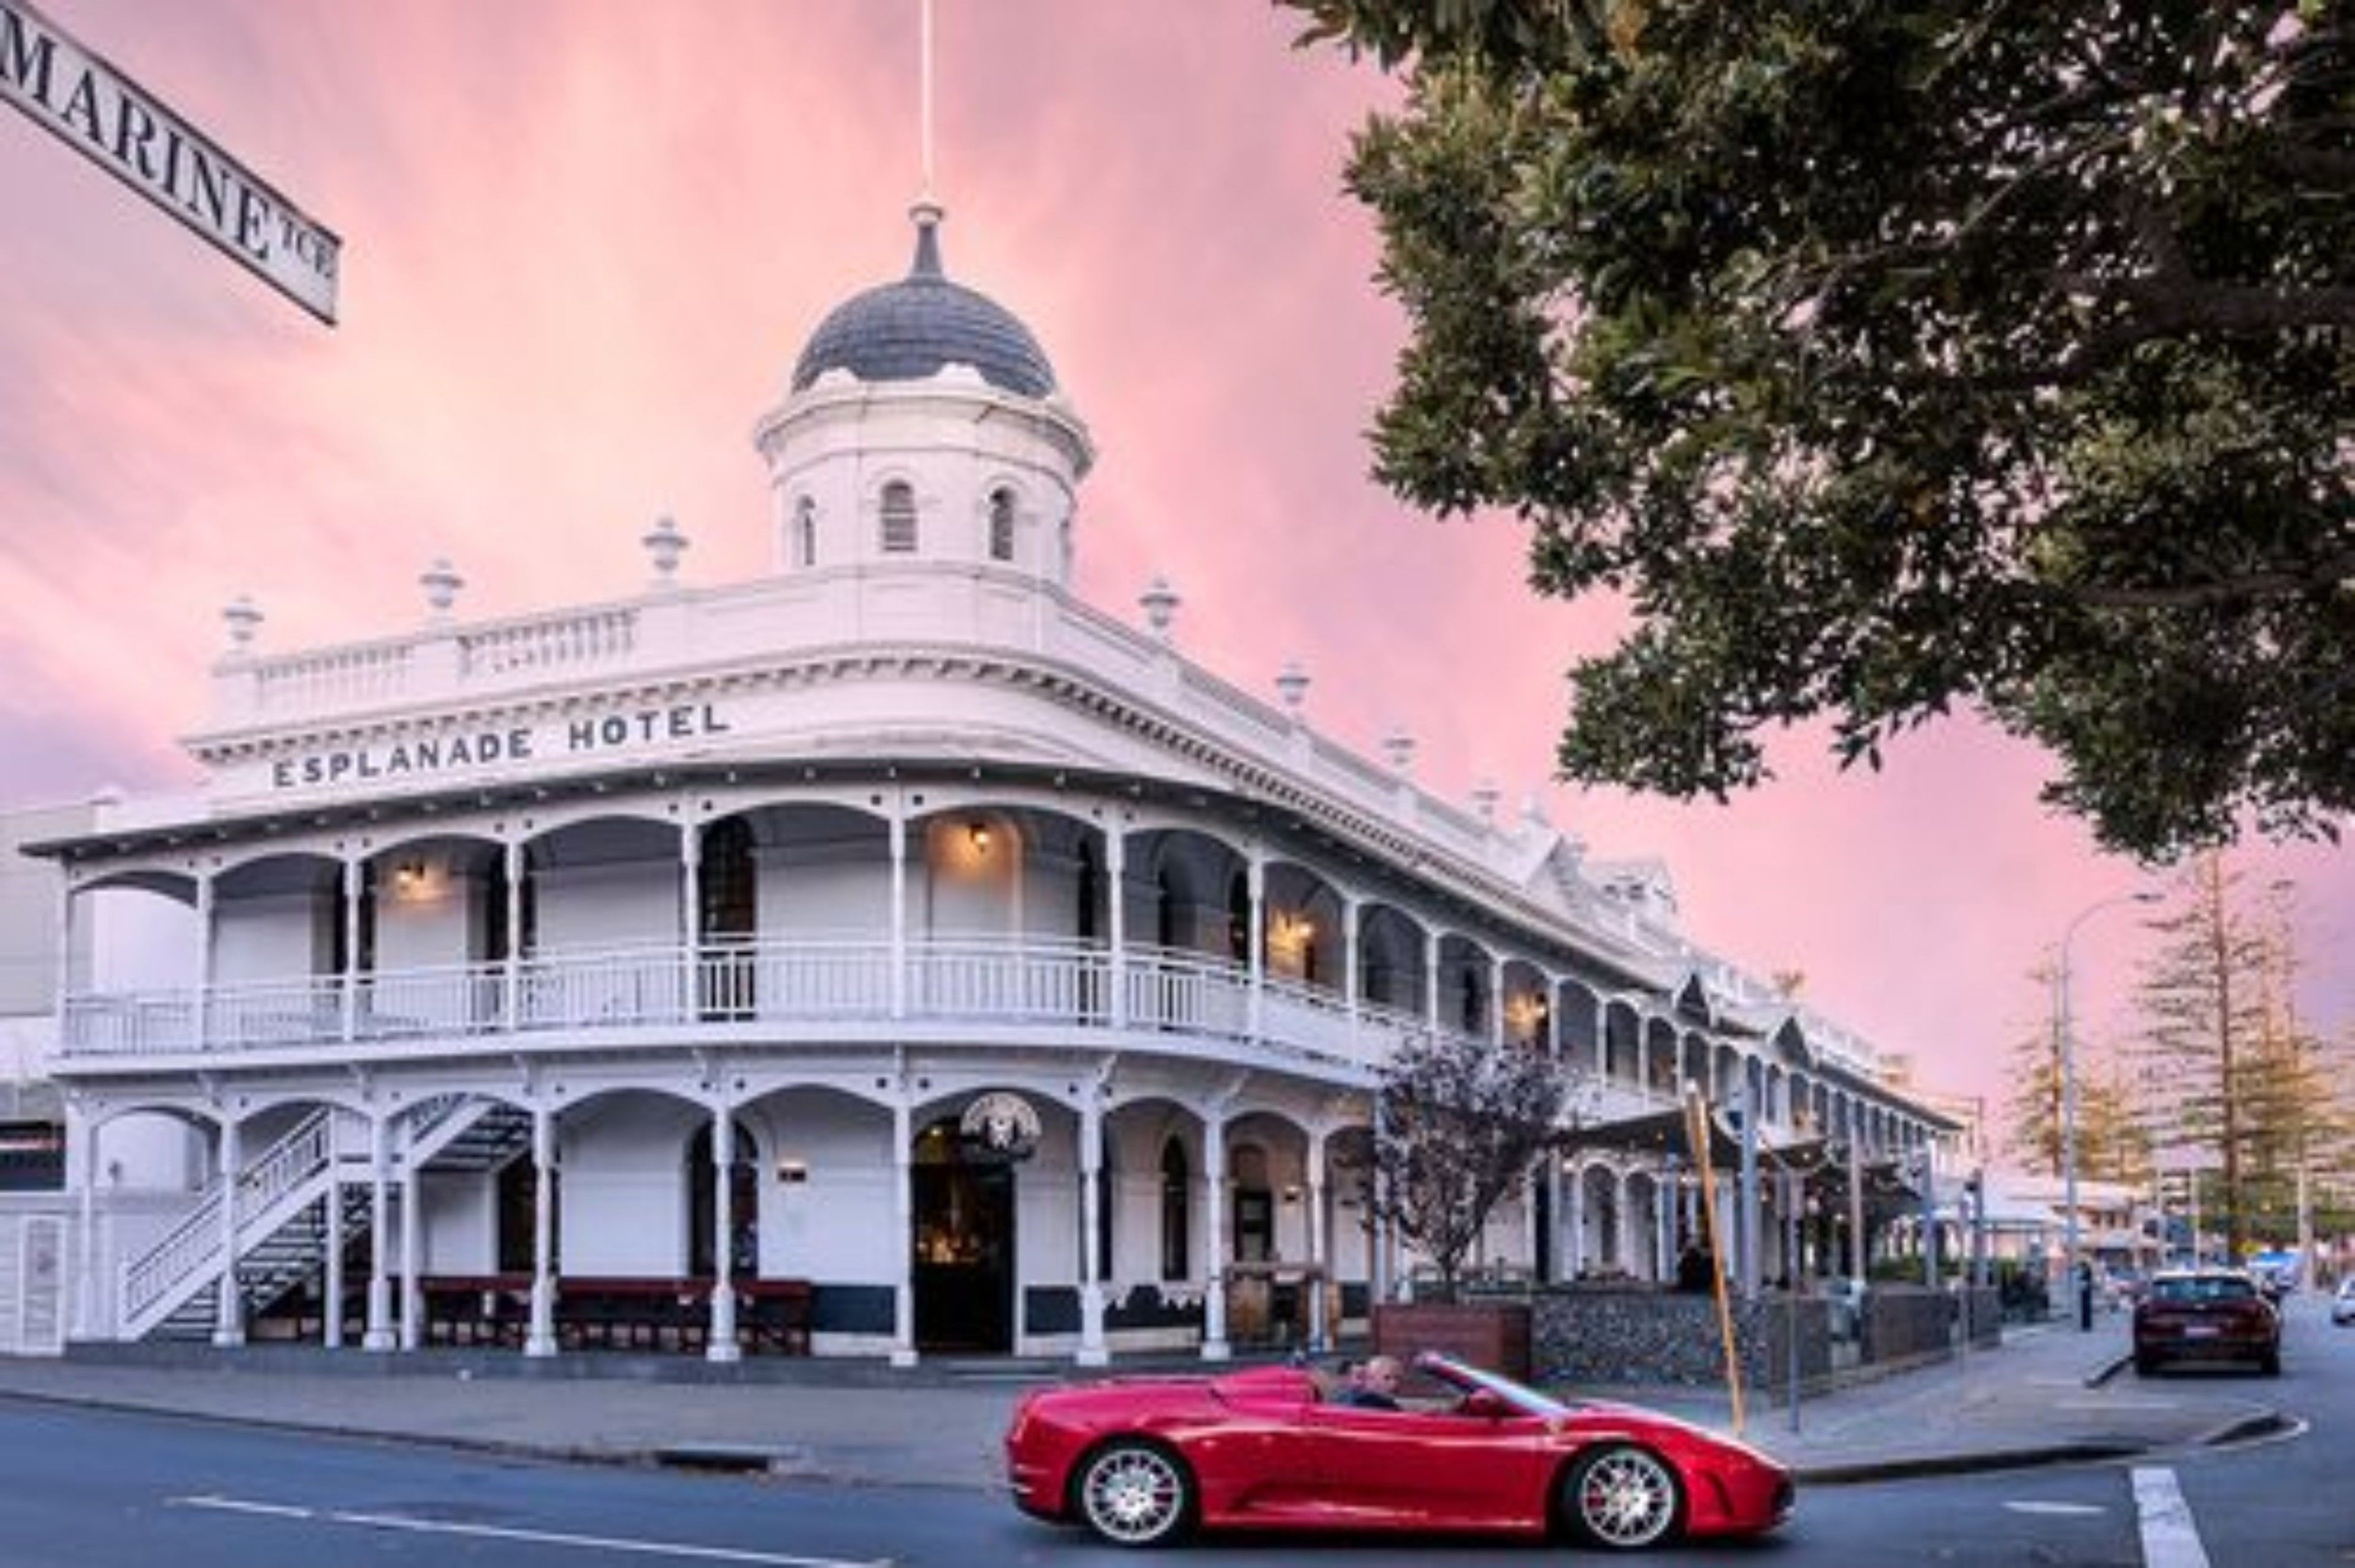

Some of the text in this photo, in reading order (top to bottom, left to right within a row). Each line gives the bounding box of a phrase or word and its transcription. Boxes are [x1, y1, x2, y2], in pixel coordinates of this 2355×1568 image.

[0, 8, 333, 278] MARINE TCE
[273, 704, 730, 787] ESPLANADE HOTEL
